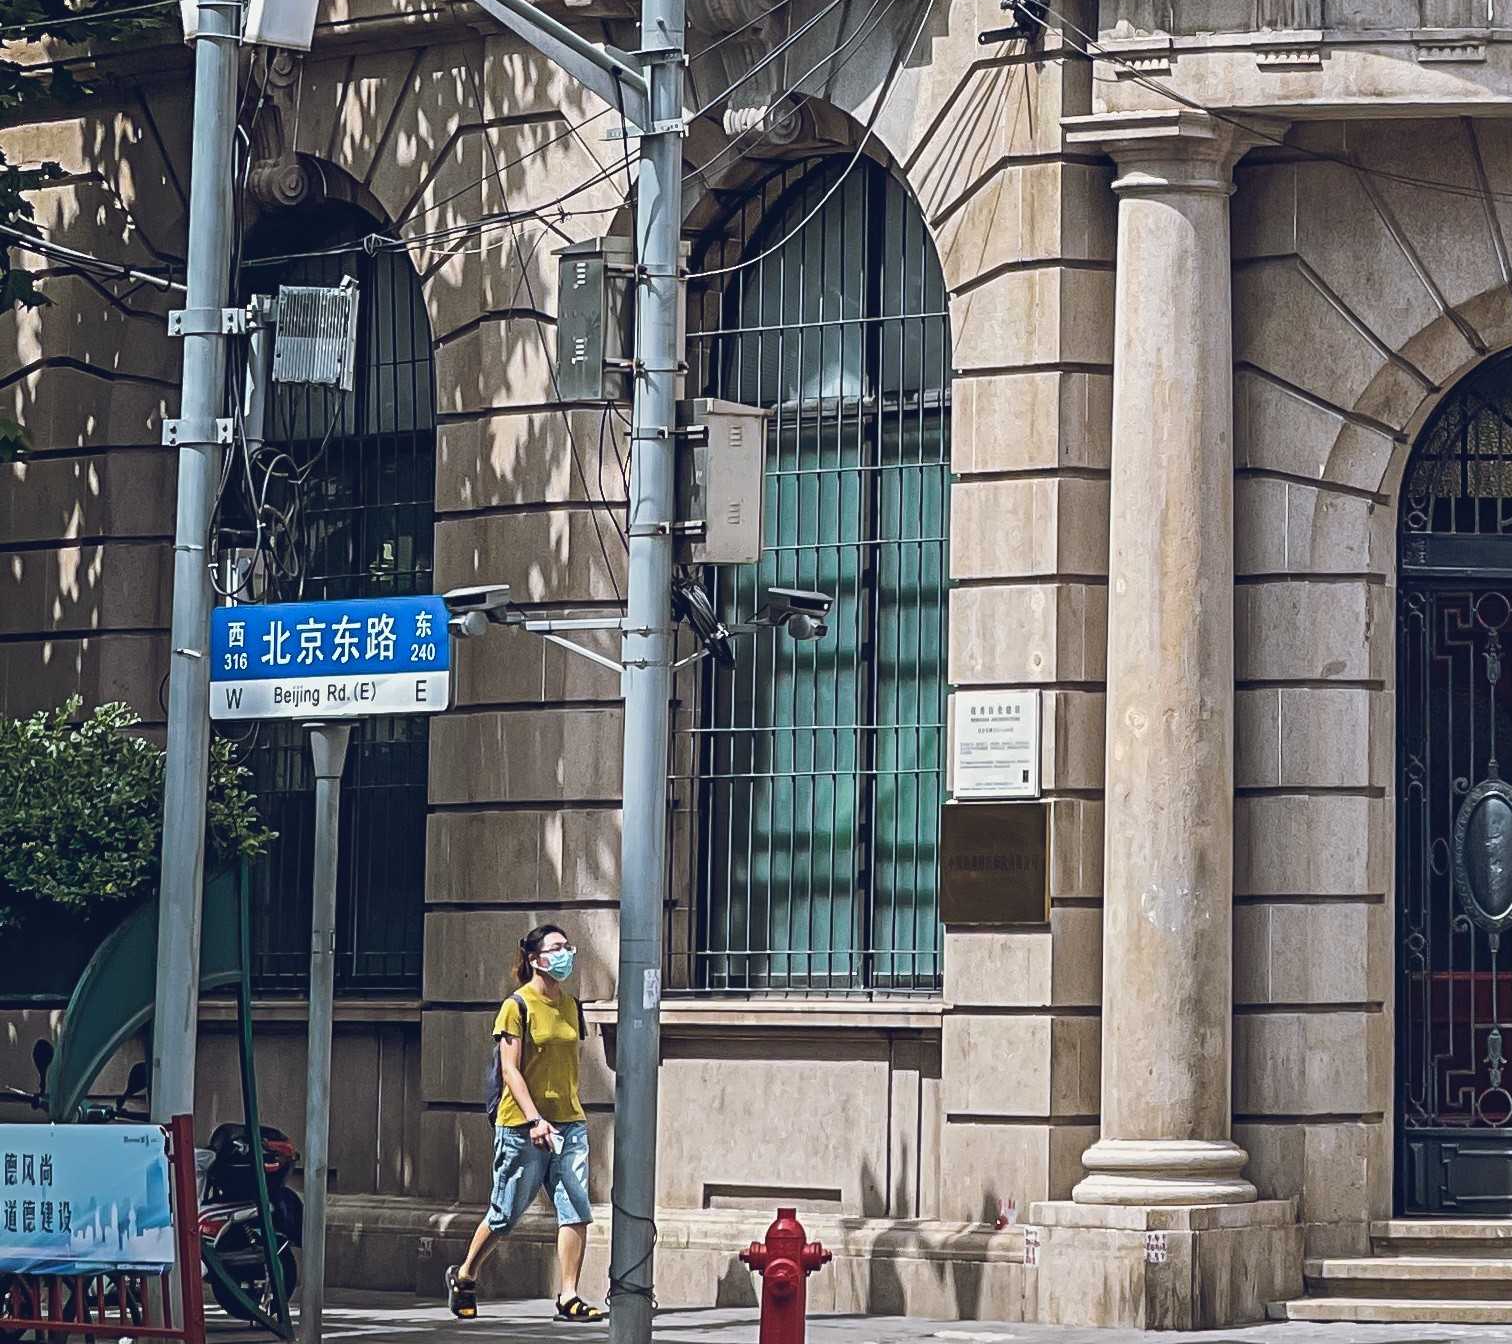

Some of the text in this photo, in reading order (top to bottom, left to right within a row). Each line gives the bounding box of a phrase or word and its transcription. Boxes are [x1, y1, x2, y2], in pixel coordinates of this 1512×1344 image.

[227, 622, 245, 648] 西
[415, 610, 433, 639] 东
[261, 613, 397, 666] 北京东路
[224, 654, 248, 671] 316
[410, 645, 436, 663] 240
[225, 687, 243, 709] W
[273, 686, 320, 708] Beijing
[415, 680, 427, 702] E
[4, 1152, 53, 1187] 德风尚
[3, 1199, 72, 1233] 道德建设
